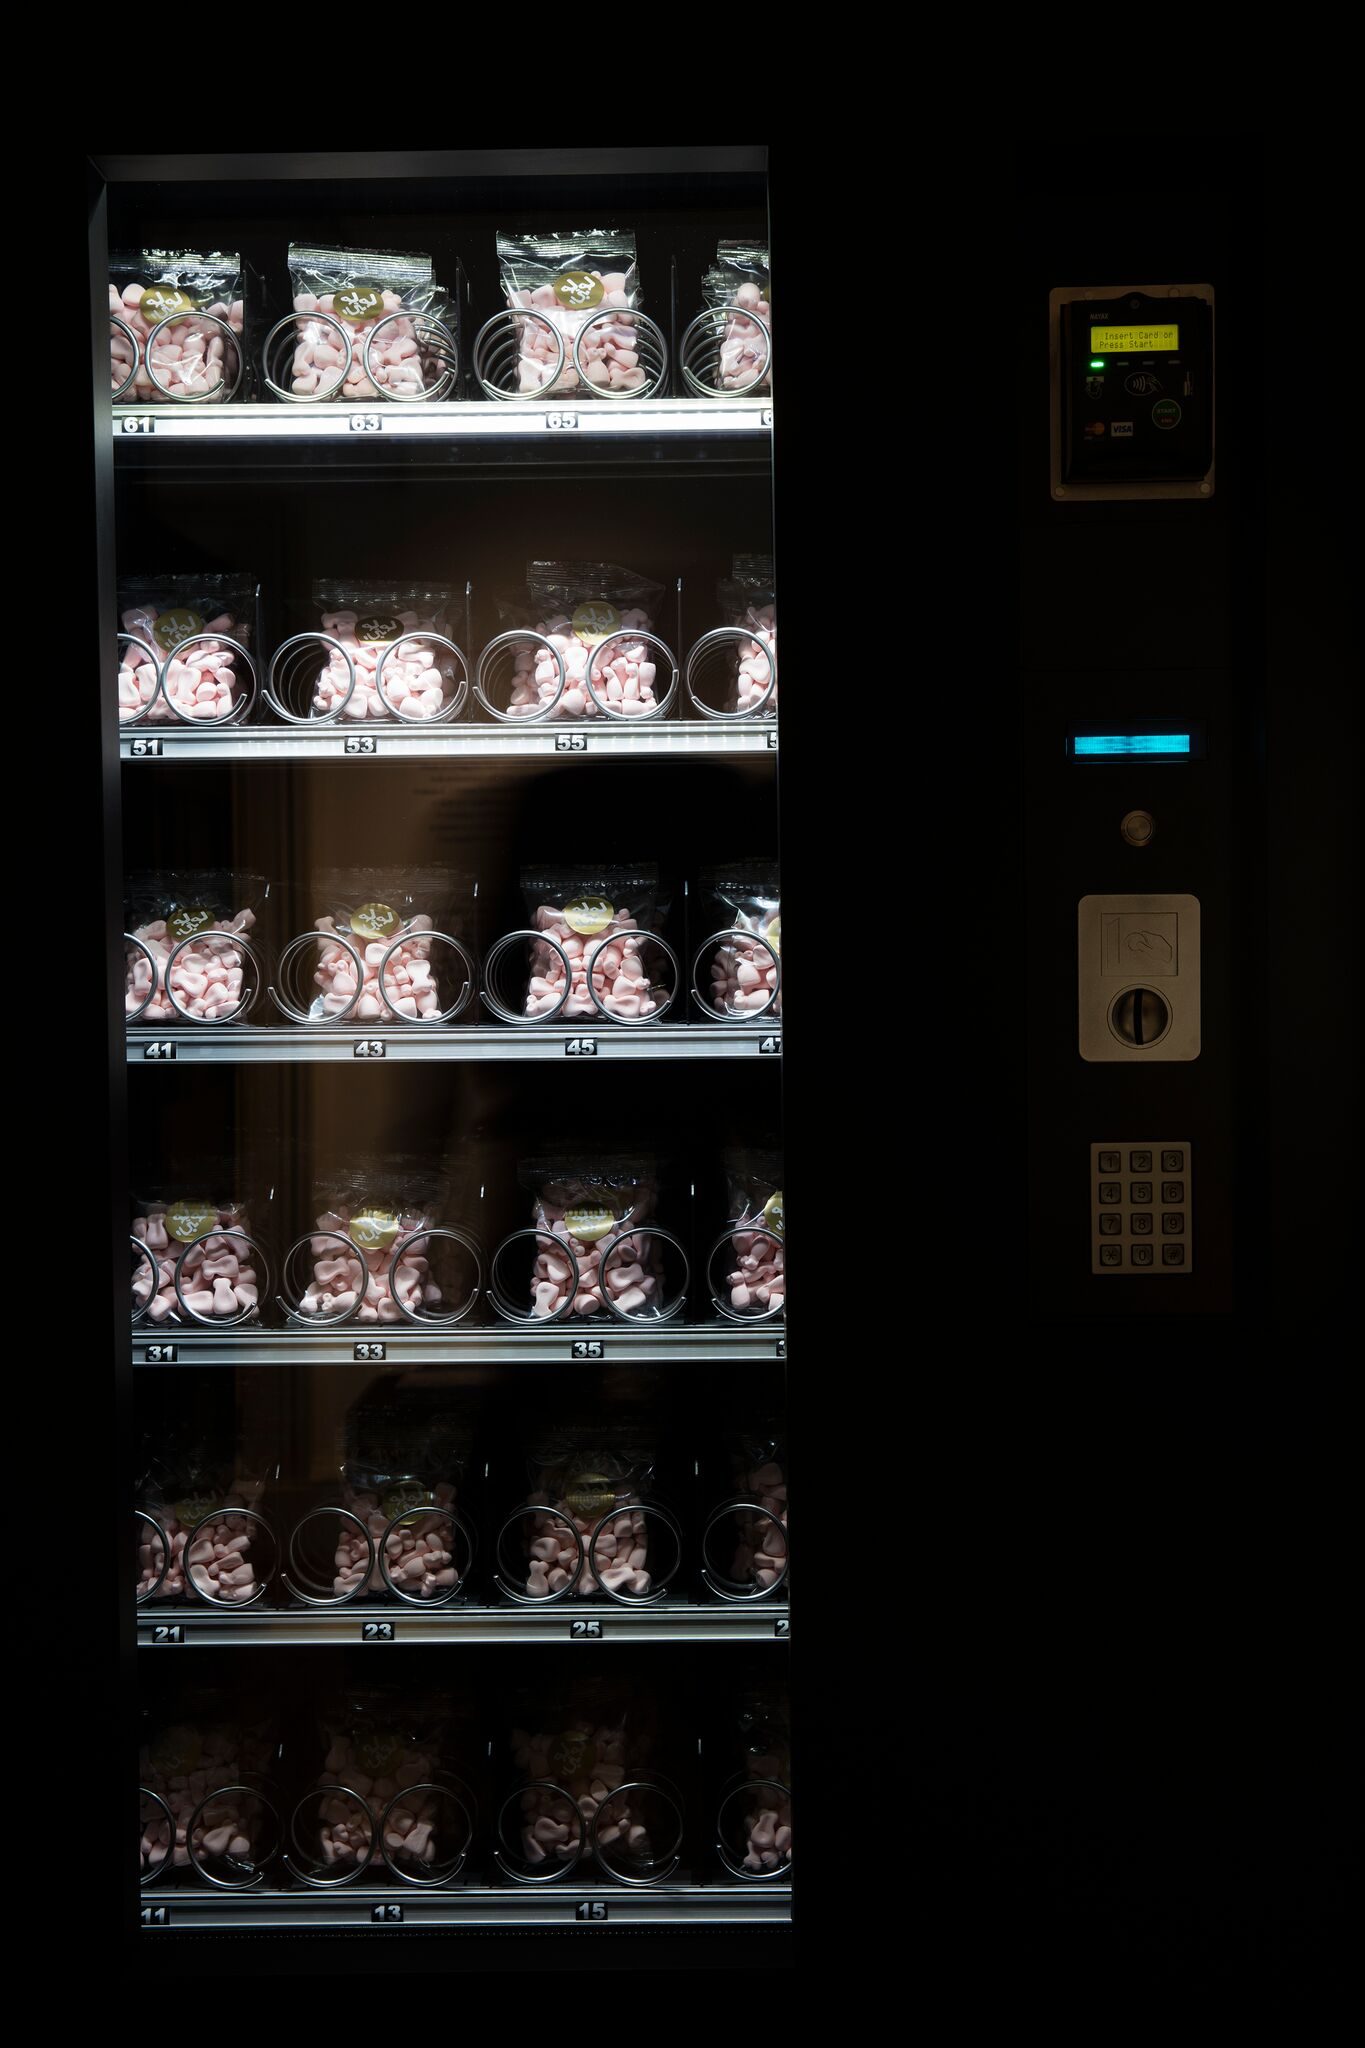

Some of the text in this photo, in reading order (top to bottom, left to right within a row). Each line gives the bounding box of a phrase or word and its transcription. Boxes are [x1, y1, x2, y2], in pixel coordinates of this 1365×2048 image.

[1105, 332, 1133, 340] Insert
[1139, 331, 1159, 340] Card
[1100, 340, 1153, 349] Press Start
[123, 417, 151, 433] 61
[351, 415, 380, 431] 63
[548, 413, 576, 429] 65
[1114, 425, 1132, 433] VISA
[132, 740, 160, 755] 51
[347, 737, 374, 753] 53
[557, 735, 584, 750] 55
[146, 1042, 173, 1058] 41
[356, 1040, 383, 1057] 43
[567, 1038, 594, 1055] 45
[1107, 1155, 1177, 1168] 1 2 3
[1106, 1188, 1177, 1199] 4 5 6
[1107, 1217, 1177, 1230] 7 8 9
[1138, 1249, 1147, 1261] 0
[148, 1345, 174, 1361] 31
[356, 1344, 383, 1360] 33
[574, 1342, 601, 1358] 35
[155, 1626, 181, 1642] 21
[364, 1623, 391, 1639] 23
[573, 1621, 600, 1637] 25
[141, 1908, 166, 1924] 11
[374, 1905, 401, 1921] 13
[578, 1903, 605, 1919] 15
